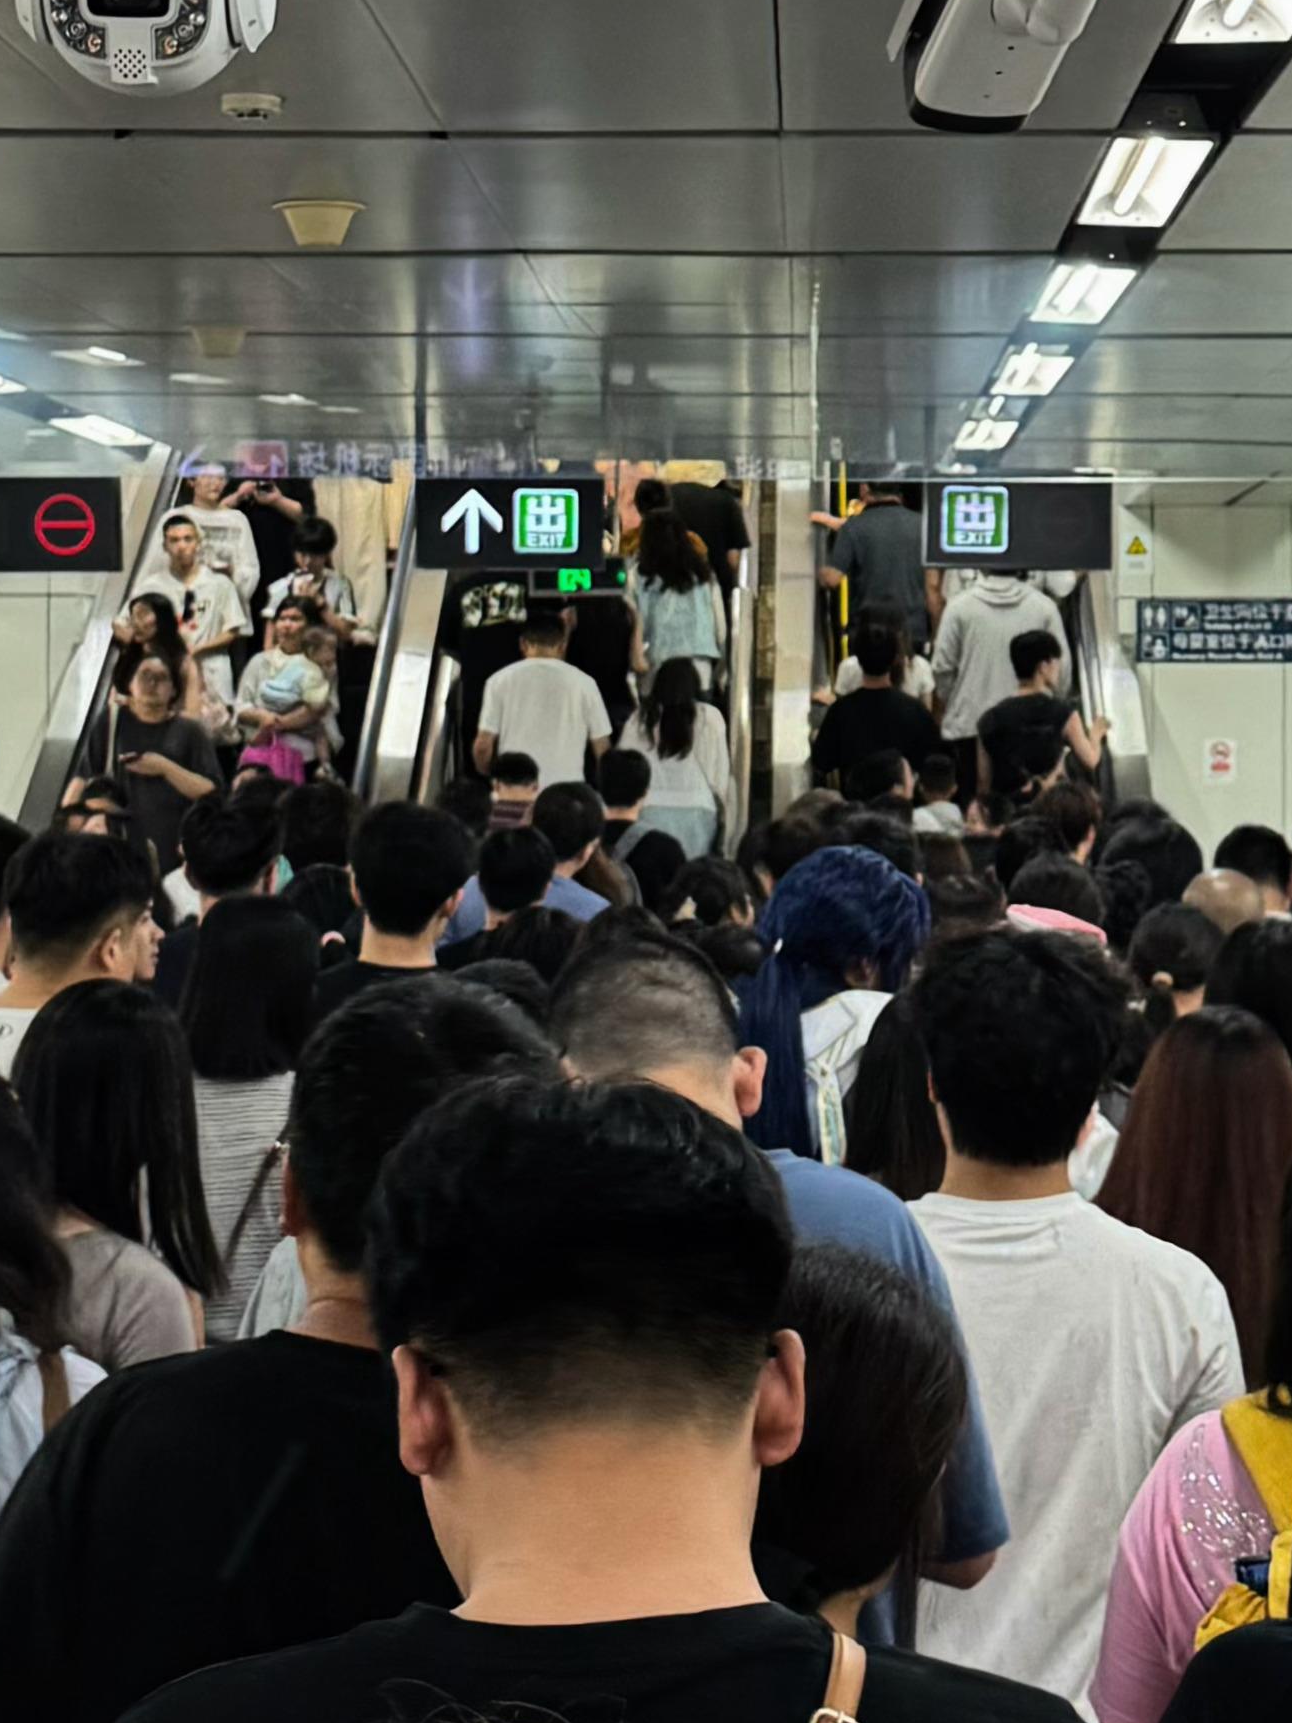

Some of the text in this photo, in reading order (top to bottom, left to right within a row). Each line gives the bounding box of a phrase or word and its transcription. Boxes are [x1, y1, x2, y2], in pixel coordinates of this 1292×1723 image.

[526, 495, 567, 533] 出
[955, 492, 996, 530] 出
[526, 534, 567, 547] EXIT
[955, 531, 994, 545] EXIT
